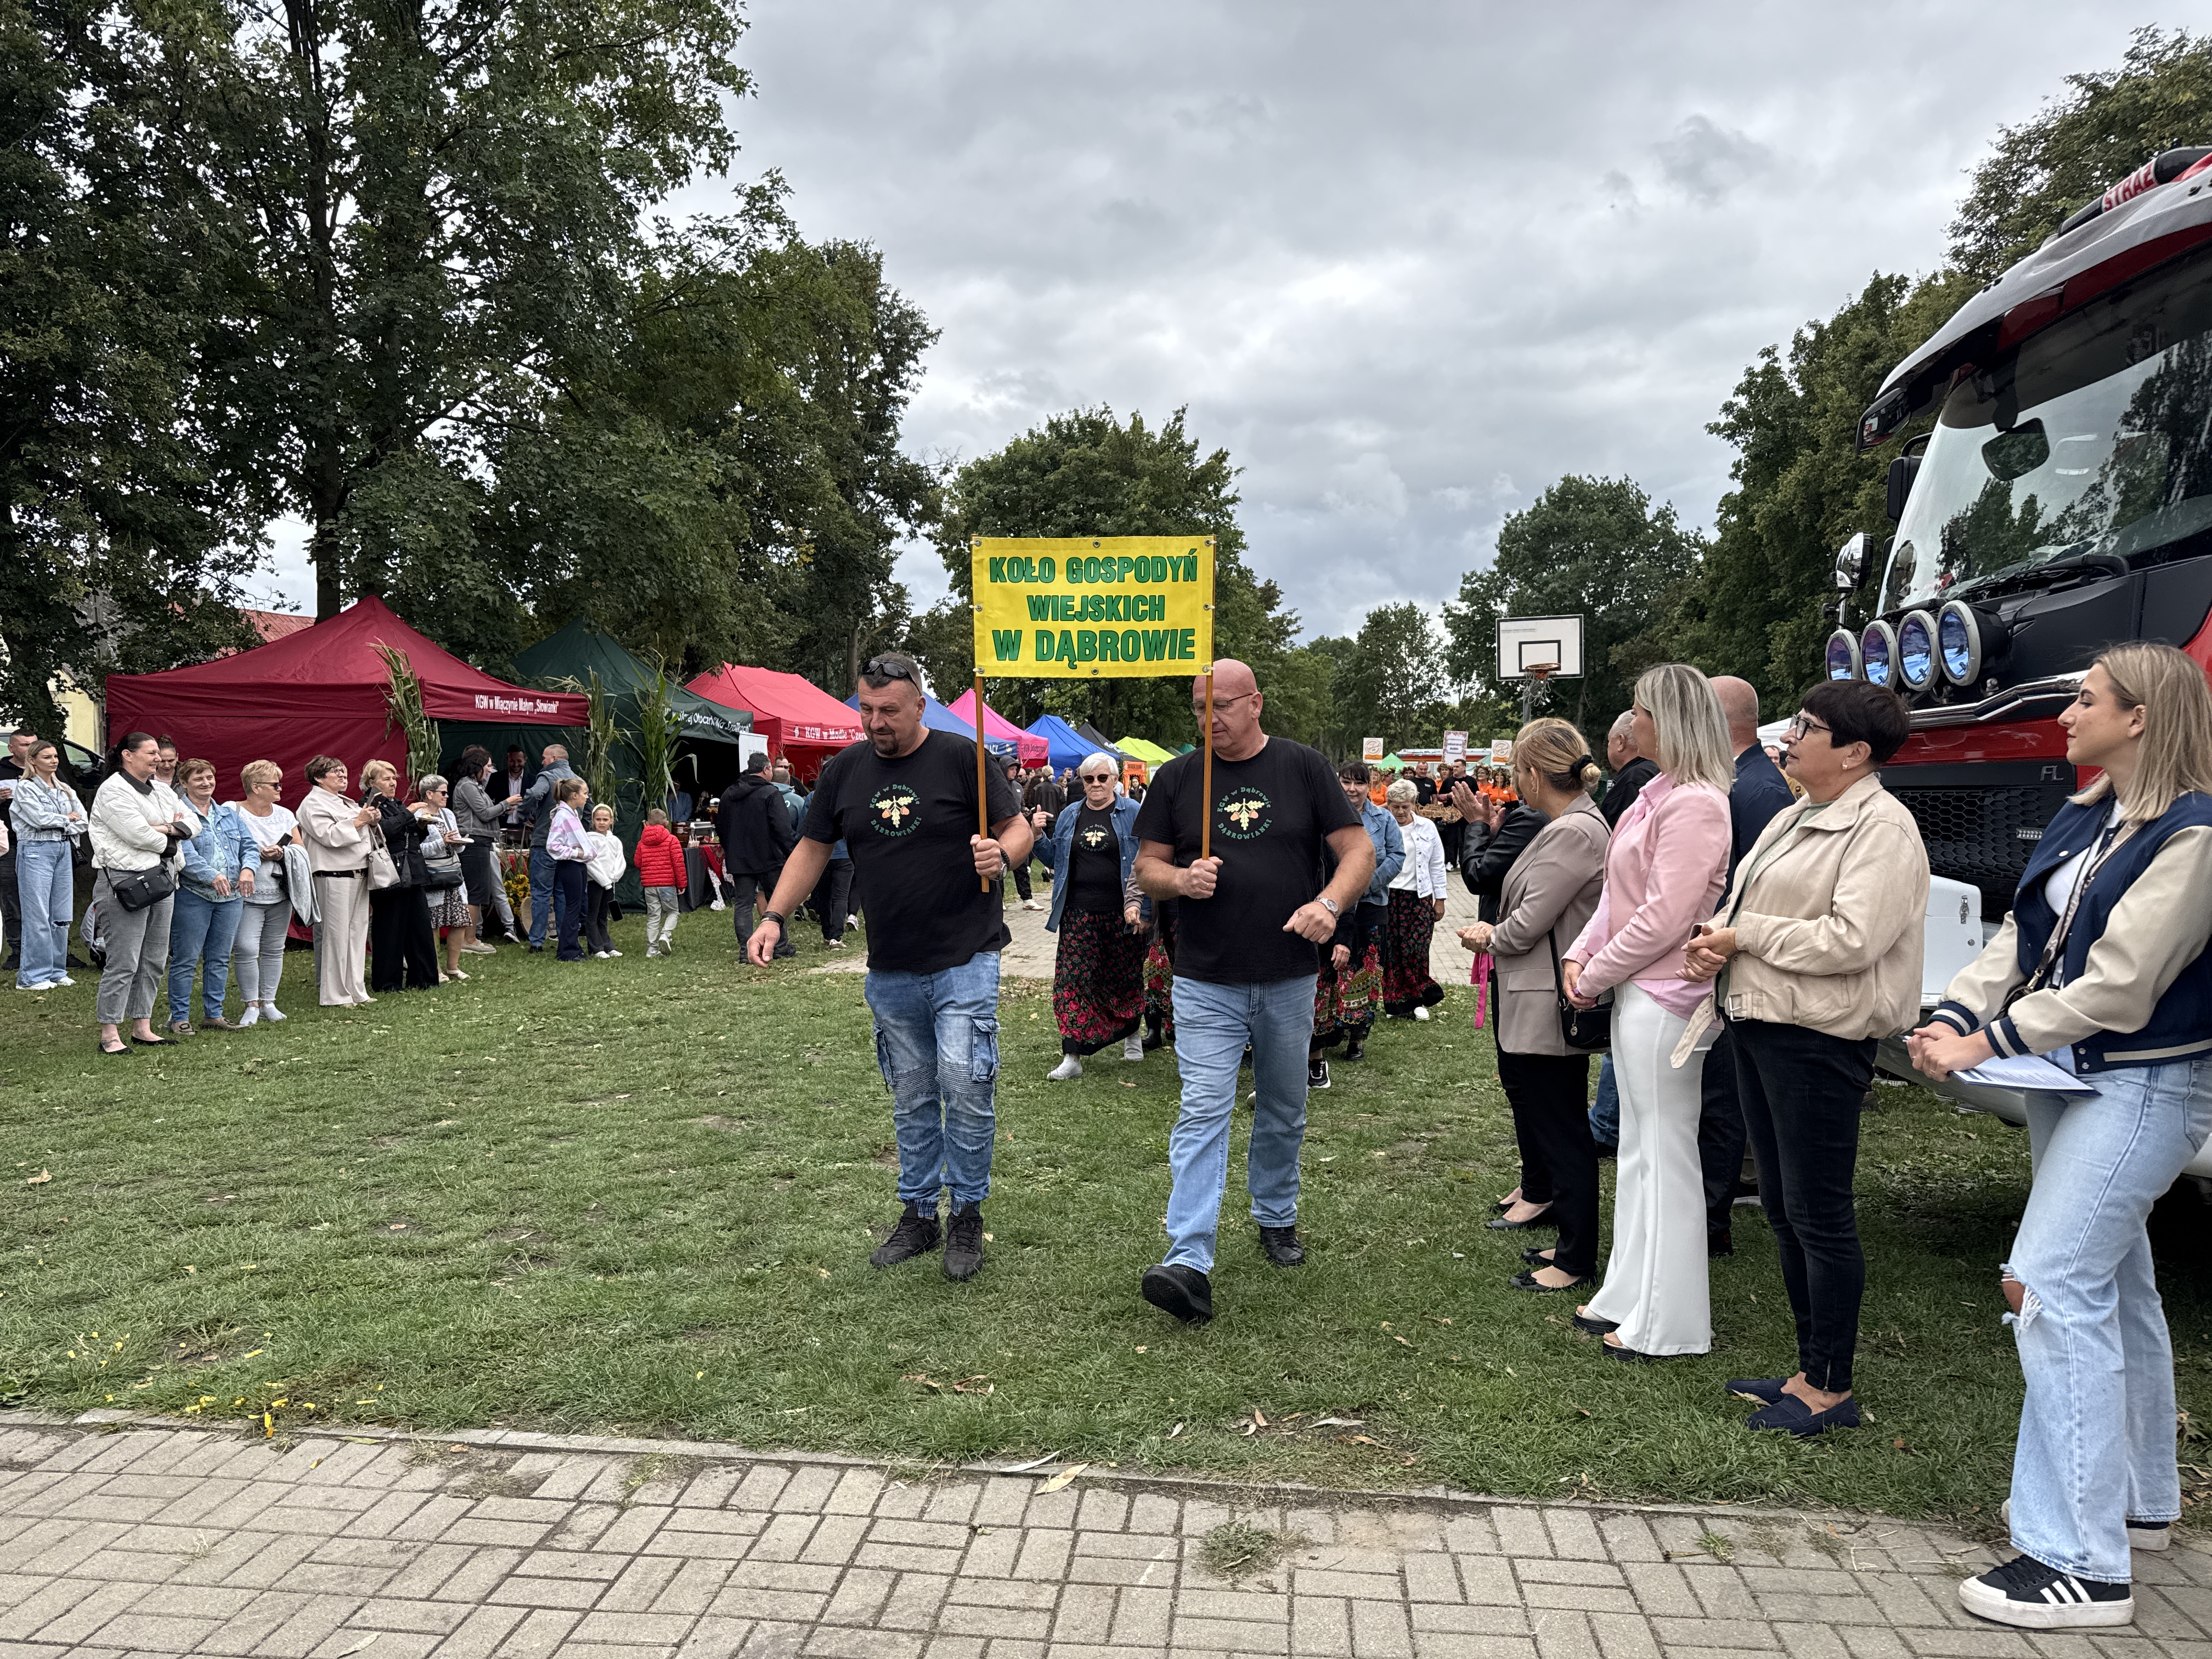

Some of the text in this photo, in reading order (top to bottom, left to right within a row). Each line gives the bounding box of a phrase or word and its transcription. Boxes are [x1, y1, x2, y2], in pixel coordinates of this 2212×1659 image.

[990, 548, 1198, 584] KOŁO GOSPODYŃ
[1026, 595, 1165, 622] WIEJSKICH
[992, 628, 1195, 669] W DĄBROWIE
[475, 695, 489, 709] KGW
[489, 699, 494, 709] w
[805, 726, 821, 739] KGW
[822, 731, 827, 740] w
[2040, 765, 2064, 781] FL
[870, 791, 881, 809] KGW
[892, 784, 921, 805] Dąbrowie
[1217, 795, 1229, 812] KGW
[1240, 787, 1272, 808] Dąbrowie
[870, 816, 922, 837] DĄBROWIANKI
[1217, 819, 1272, 839] DĄBROWIANKI
